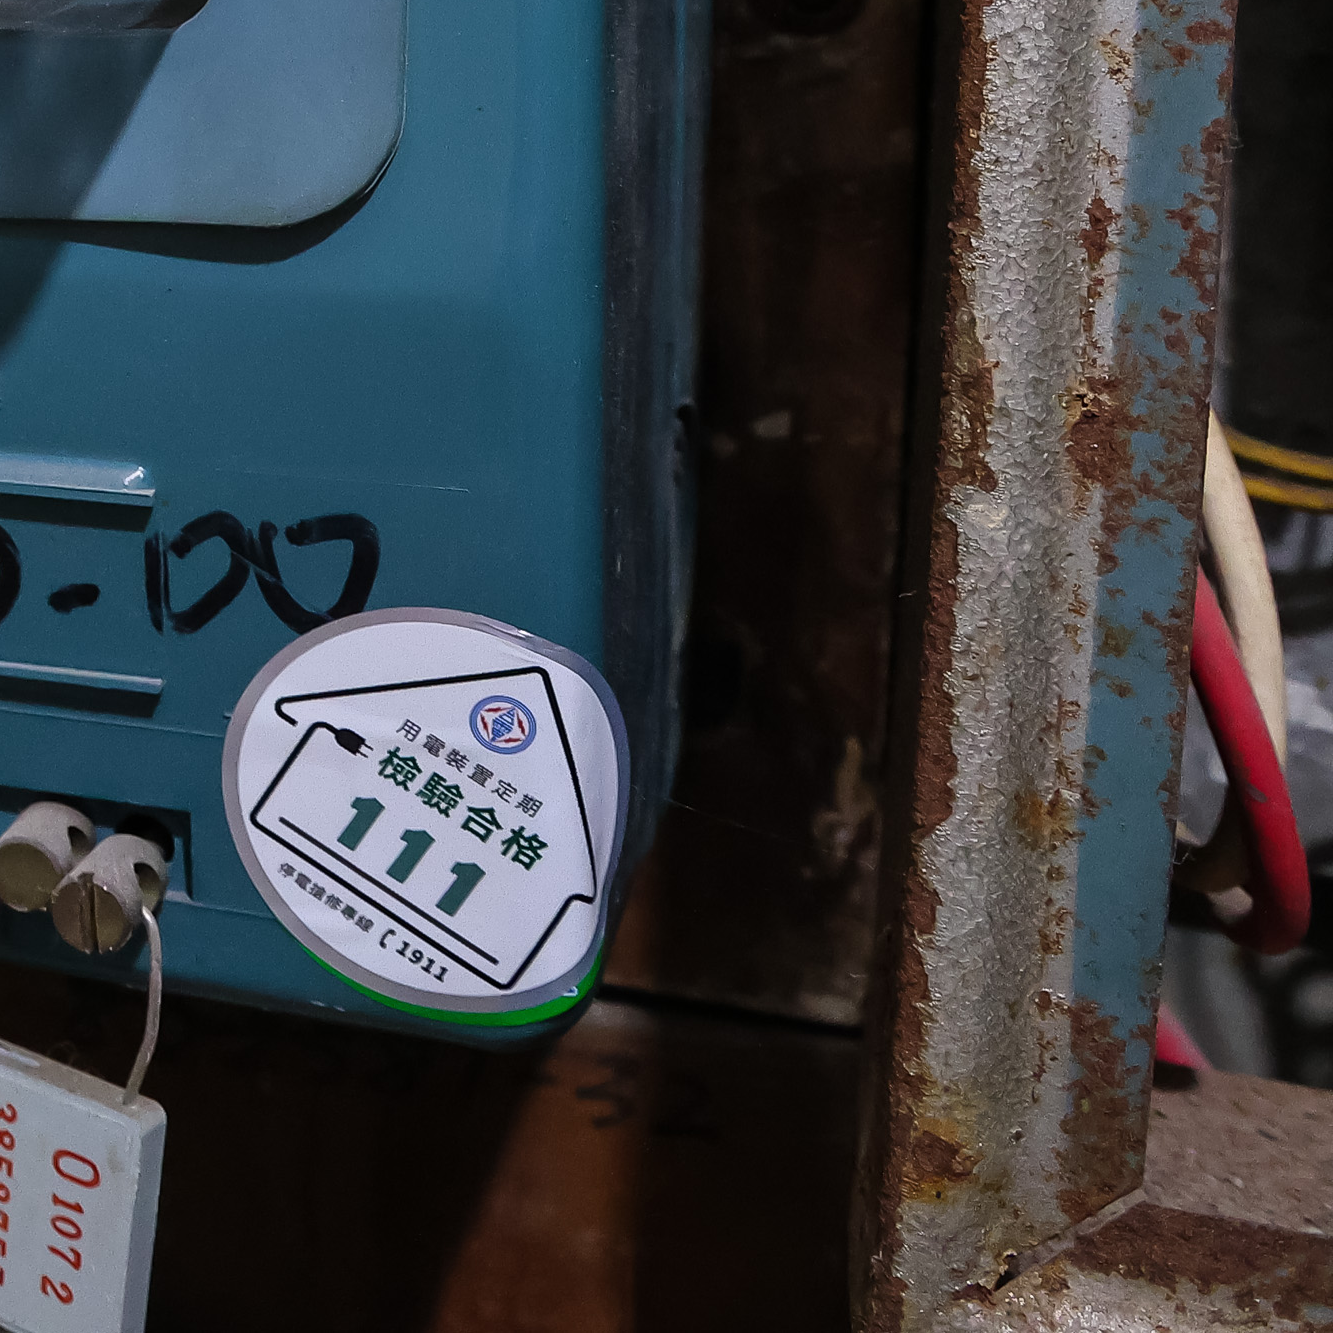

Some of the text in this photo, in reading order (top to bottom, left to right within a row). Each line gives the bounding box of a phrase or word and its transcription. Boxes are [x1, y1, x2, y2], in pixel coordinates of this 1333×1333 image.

[377, 746, 550, 872] 檢驗合格
[396, 718, 545, 819] 用電裝置定期
[336, 796, 487, 917] 111
[395, 940, 450, 983] 1911
